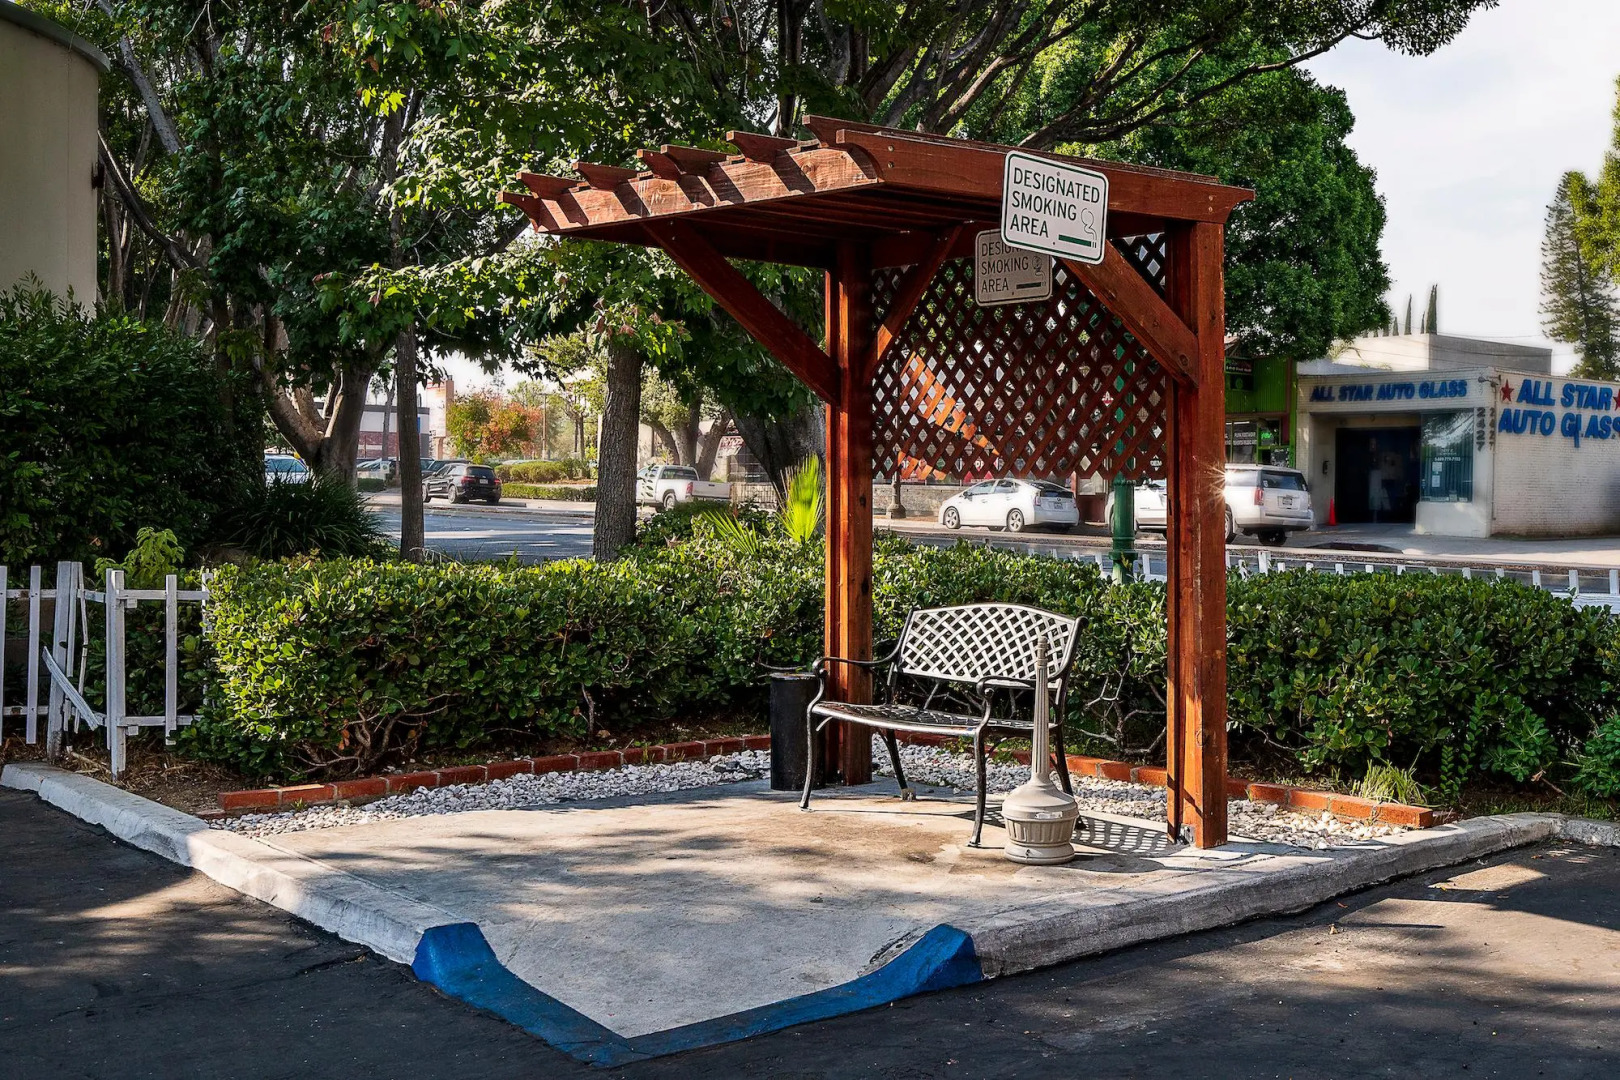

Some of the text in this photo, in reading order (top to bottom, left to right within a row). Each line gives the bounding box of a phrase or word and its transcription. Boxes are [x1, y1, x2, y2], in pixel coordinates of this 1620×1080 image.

[1013, 167, 1100, 204] DESIGNATED
[1011, 190, 1077, 221] SMOKING
[1009, 213, 1049, 238] AREA
[981, 241, 1023, 257] DESIG
[981, 256, 1029, 275] SMOKING
[981, 277, 1009, 293] AREA
[1310, 379, 1468, 402] ALL STAR AUTO GLASS
[1516, 378, 1613, 411] ALL STAR
[1475, 407, 1486, 452] 2427
[1498, 408, 1556, 437] AUTO
